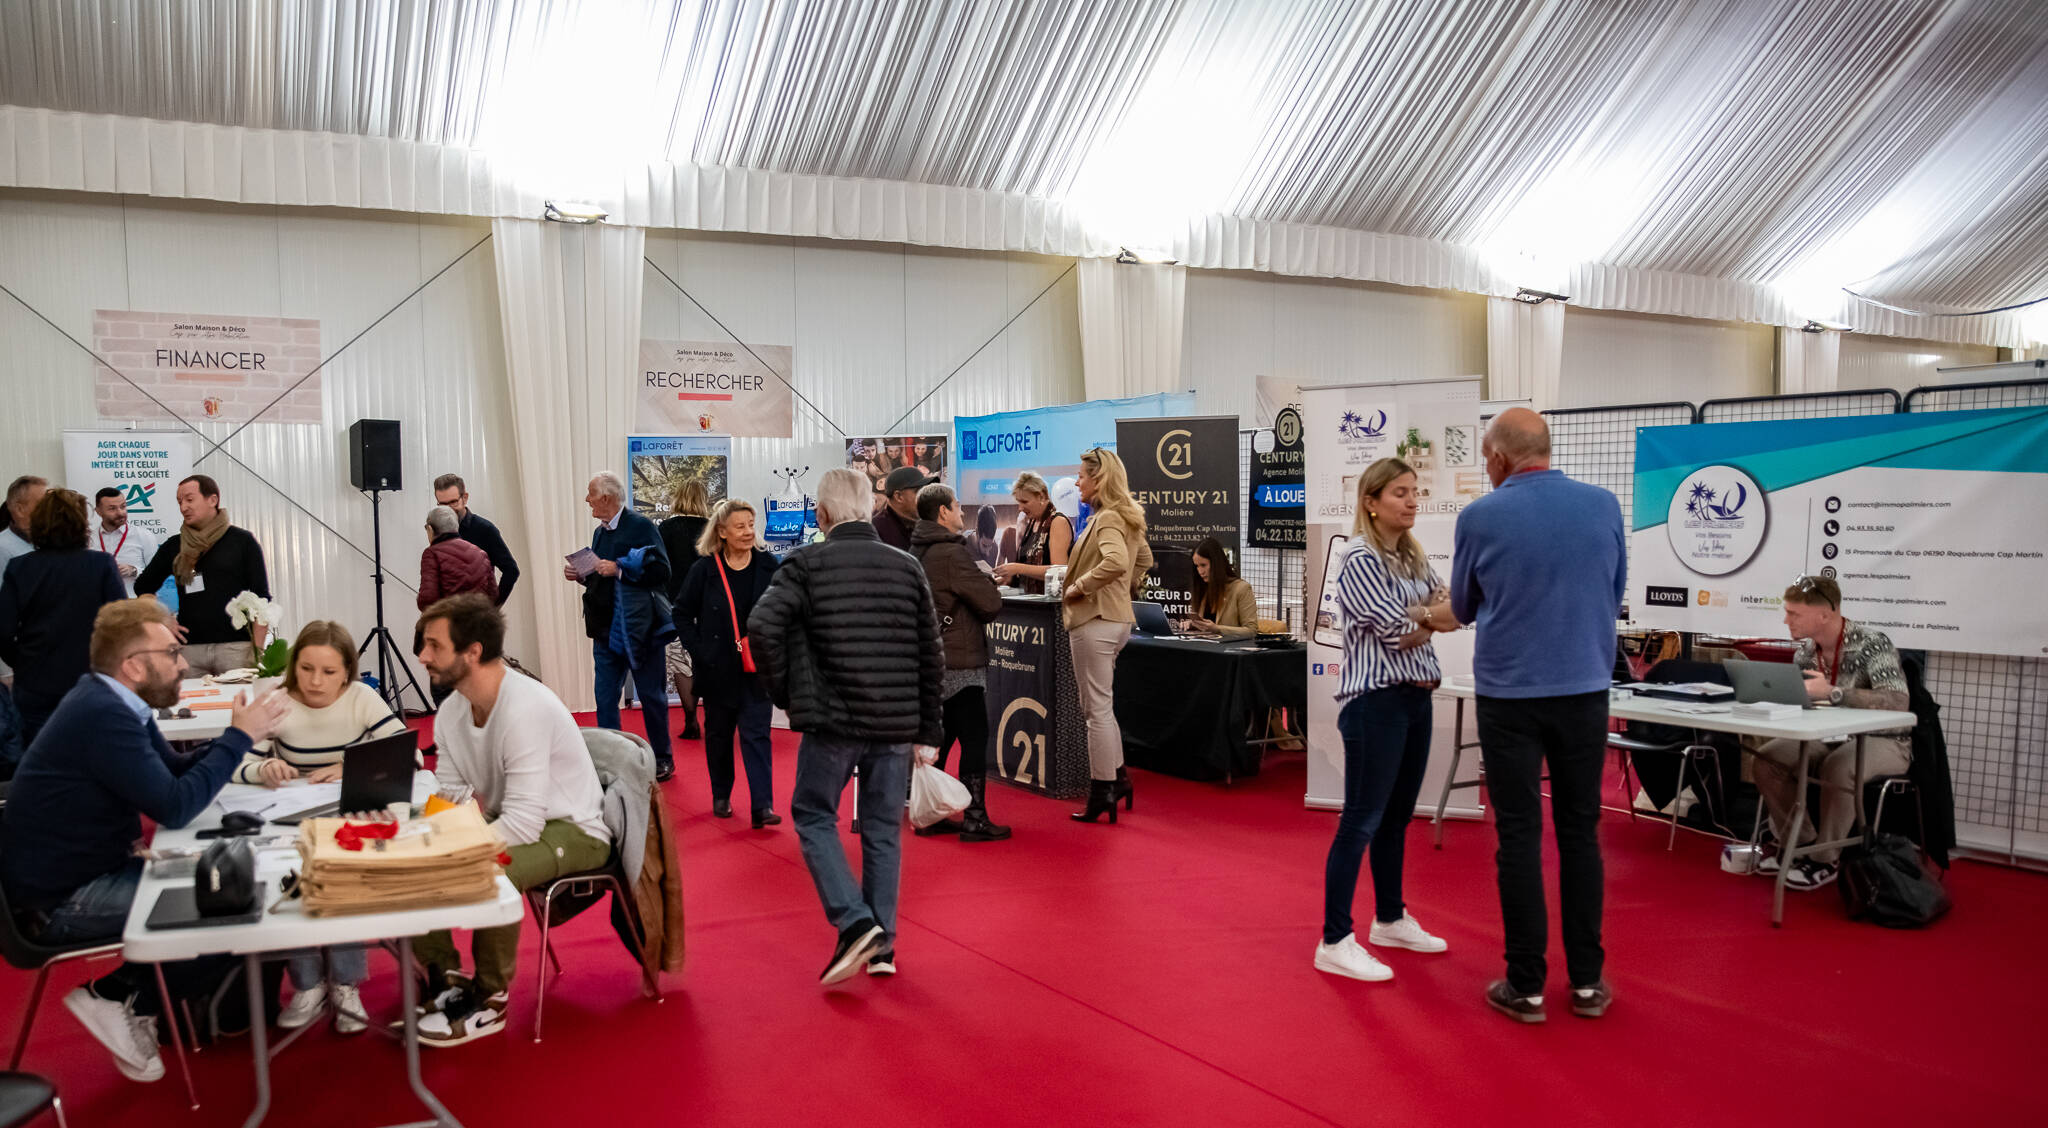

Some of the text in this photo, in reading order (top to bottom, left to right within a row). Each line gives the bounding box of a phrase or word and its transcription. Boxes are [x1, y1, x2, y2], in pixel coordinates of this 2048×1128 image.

[174, 323, 194, 331] Salon
[195, 324, 221, 332] Maison
[156, 349, 266, 370] FINANCER
[646, 371, 764, 391] RECHERCHER
[1283, 422, 1294, 437] 21
[97, 441, 150, 449] AGIR CHAQUE
[97, 450, 169, 459] JOUR DANS VOTRE
[1168, 443, 1191, 466] 21
[91, 459, 124, 469] INTÉRÊT
[136, 461, 159, 469] CELUI
[114, 469, 169, 479] DE LA SOCIÉTÉ
[1263, 469, 1287, 478] Agence
[1212, 490, 1228, 504] 21
[1264, 486, 1273, 503] À
[1160, 508, 1194, 517] Molière
[1154, 524, 1194, 533] Roquebrune
[1196, 524, 1211, 533] Cap
[1212, 524, 1237, 532] Martin
[1853, 548, 1893, 556] Promenade
[1905, 550, 1921, 558] Cap
[1946, 550, 1995, 558] Roquebrune
[1996, 551, 2014, 559] Cap
[1146, 577, 1161, 587] AU
[1146, 590, 1181, 601] CŒUR
[1926, 623, 1960, 632] Palmiers
[1031, 626, 1045, 645] 21
[994, 645, 1015, 657] Molière
[1001, 658, 1036, 672] Roquebrune
[1012, 730, 1046, 789] 21
